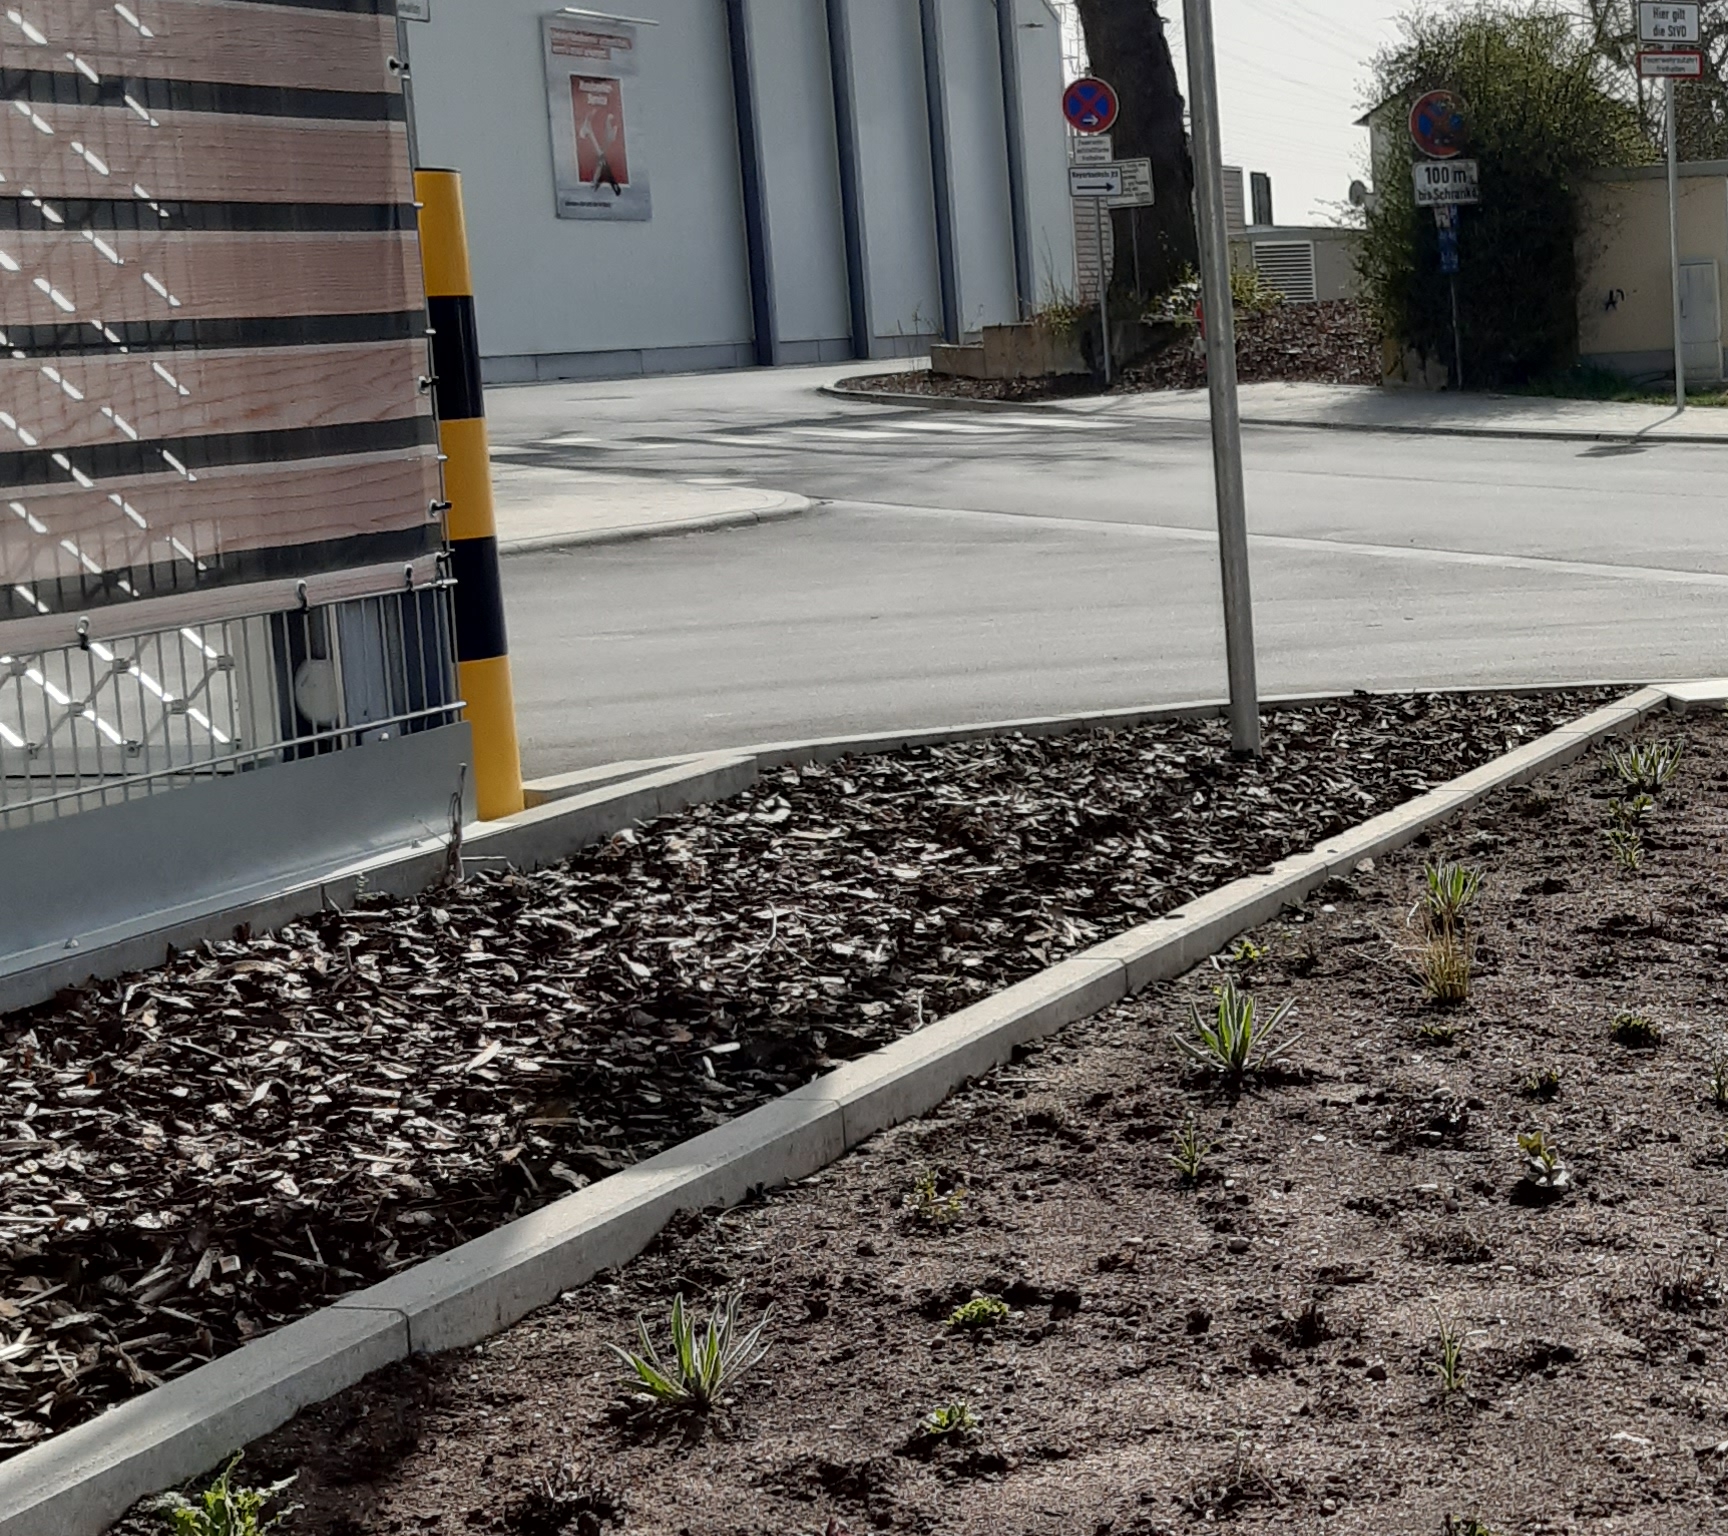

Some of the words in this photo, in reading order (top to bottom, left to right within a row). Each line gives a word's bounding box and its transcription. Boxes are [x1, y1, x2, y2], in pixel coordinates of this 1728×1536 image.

[1653, 7, 1669, 19] Hier
[1672, 7, 1686, 22] gilt
[1653, 24, 1665, 36] die
[1668, 25, 1687, 37] StVO
[1425, 166, 1449, 185] 100
[1454, 170, 1467, 184] m
